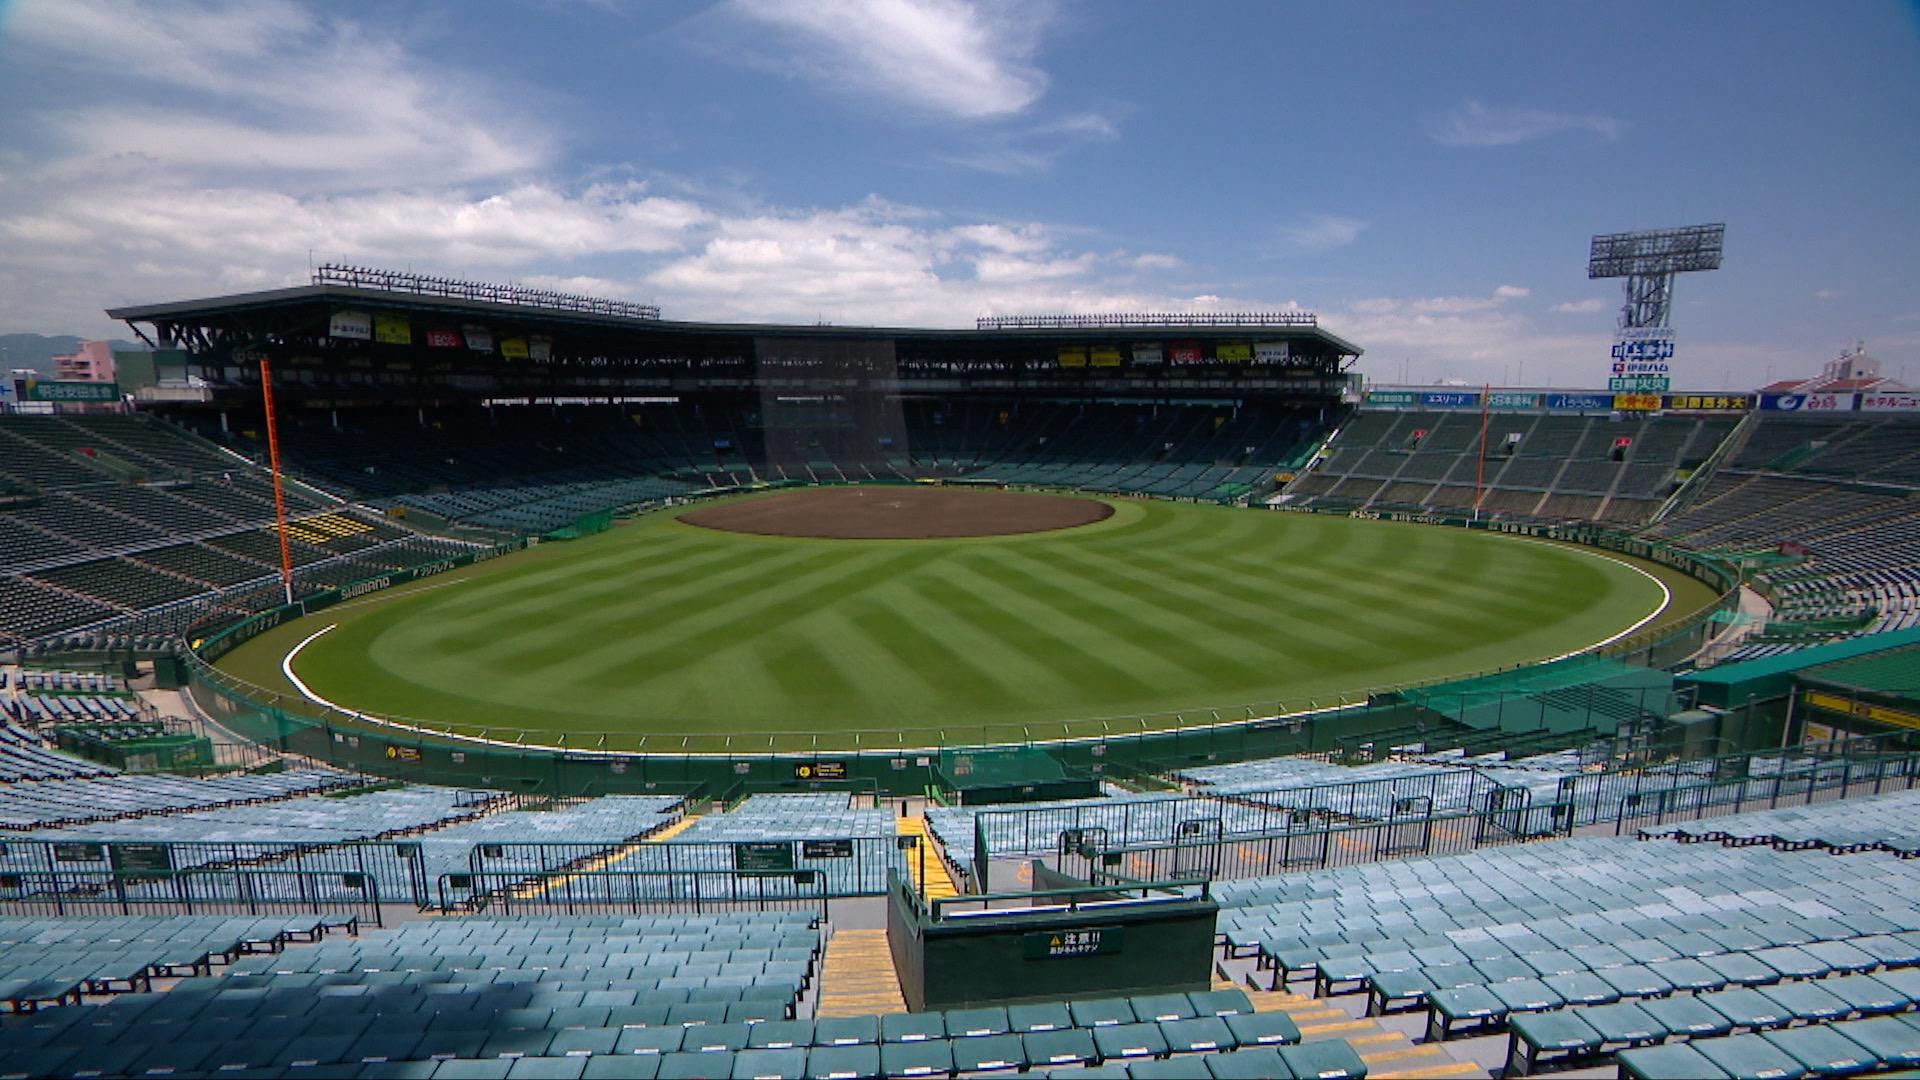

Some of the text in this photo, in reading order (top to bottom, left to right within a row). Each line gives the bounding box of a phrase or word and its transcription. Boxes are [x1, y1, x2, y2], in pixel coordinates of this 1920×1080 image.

[1865, 396, 1920, 407] ホテルニュ
[341, 577, 390, 600] SHIMANO
